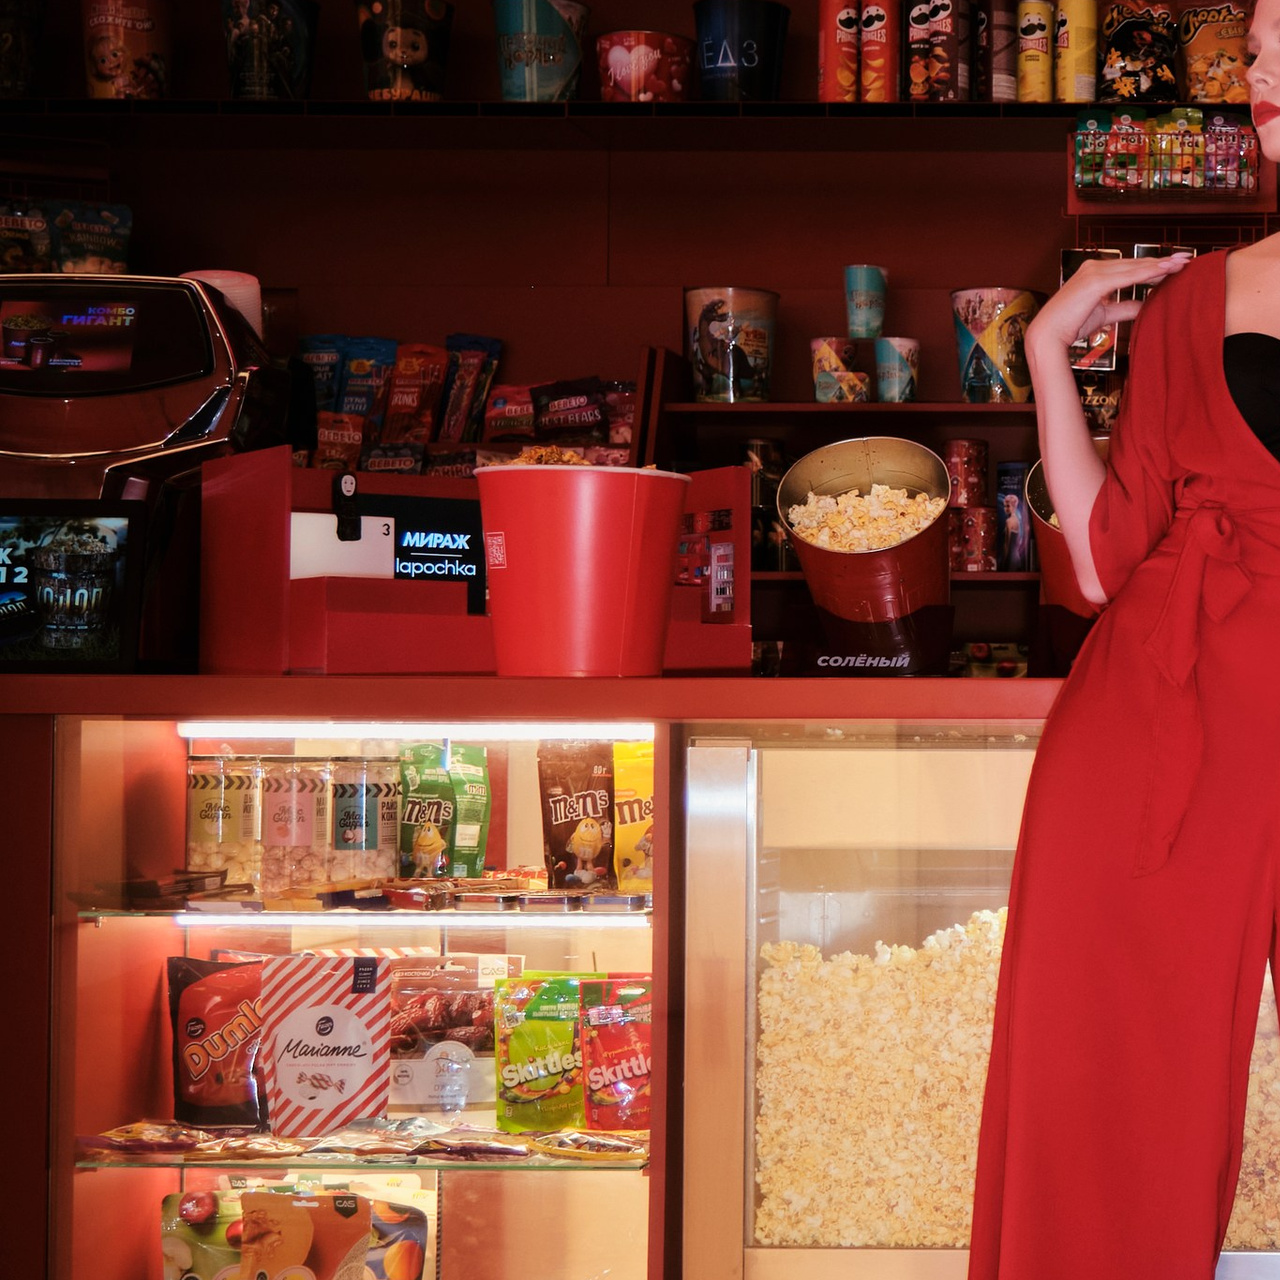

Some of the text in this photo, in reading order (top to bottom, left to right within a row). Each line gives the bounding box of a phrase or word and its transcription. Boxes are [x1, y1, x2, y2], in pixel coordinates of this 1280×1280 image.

[701, 37, 737, 70] ЁД
[61, 315, 135, 326] ГИГАНТ
[1080, 395, 1118, 406] IZZON
[369, 458, 416, 471] BEBETO
[382, 523, 391, 536] 3
[401, 531, 472, 551] МИРАЖ
[395, 557, 477, 578] lapochka
[816, 652, 911, 669] СОЛЁНЫЙ
[278, 1038, 368, 1064] Marianne
[335, 1199, 356, 1209] CAS
